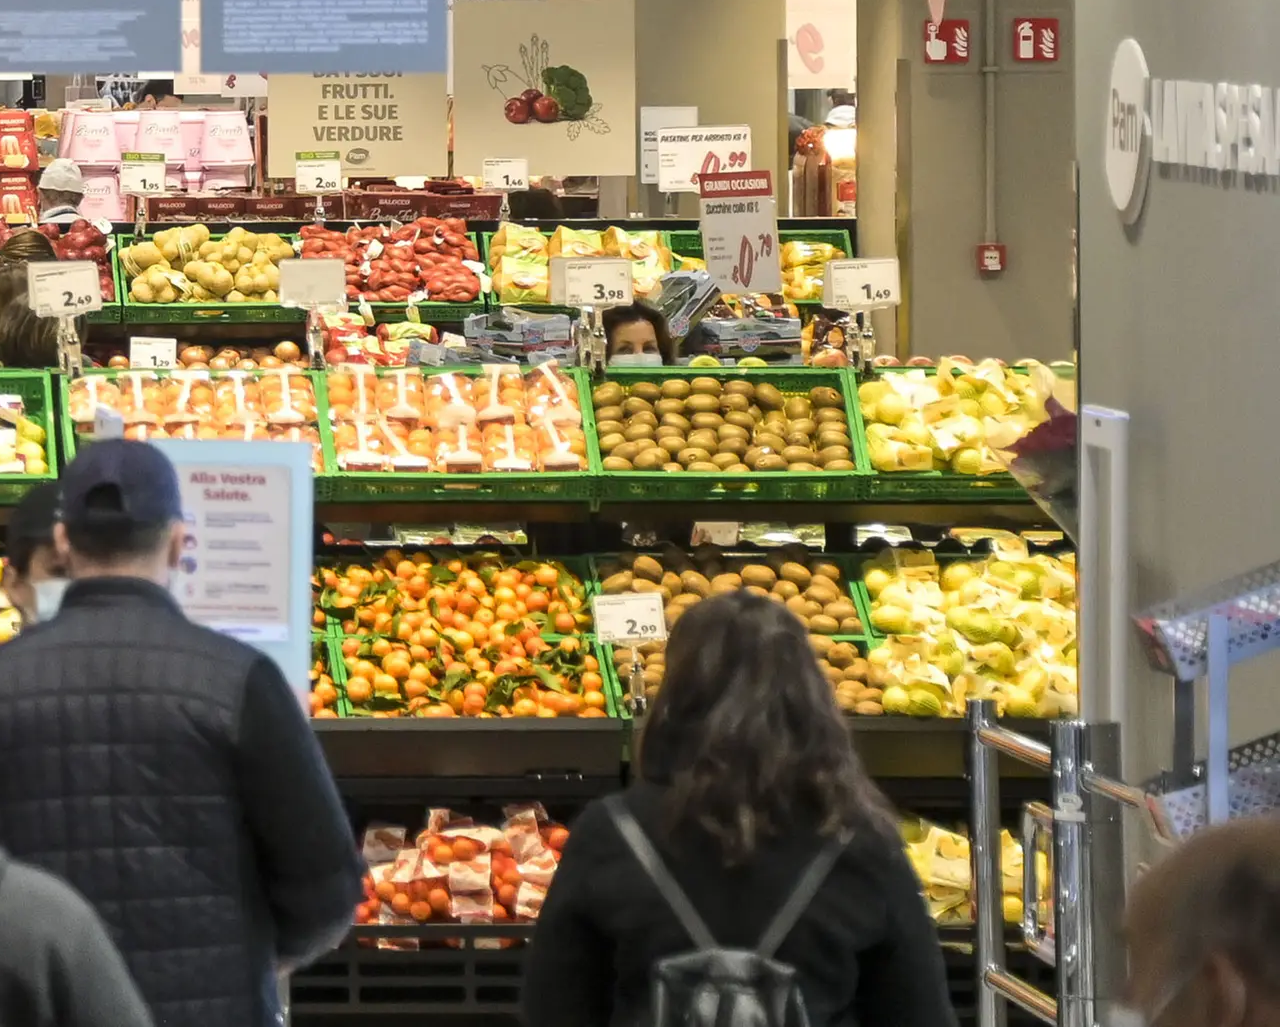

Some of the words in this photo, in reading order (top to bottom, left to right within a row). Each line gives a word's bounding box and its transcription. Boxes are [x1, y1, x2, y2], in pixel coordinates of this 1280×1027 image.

[322, 83, 394, 99] FRUTTI.
[318, 105, 328, 120] E
[334, 105, 356, 120] LE
[361, 104, 398, 120] SUE
[1111, 88, 1138, 154] Pam
[312, 125, 403, 142] VERDURE
[140, 179, 160, 191] 1,95
[315, 177, 337, 189] 2,00
[503, 175, 523, 187] 1,46
[704, 180, 731, 192] GRANDI
[731, 178, 768, 191] OCCASIONI
[62, 291, 92, 309] 2,49
[593, 284, 625, 302] 3,98
[861, 284, 891, 302] 1,49
[151, 356, 170, 368] 1,29
[220, 473, 267, 486] Vostra
[626, 619, 657, 636] 2,99
